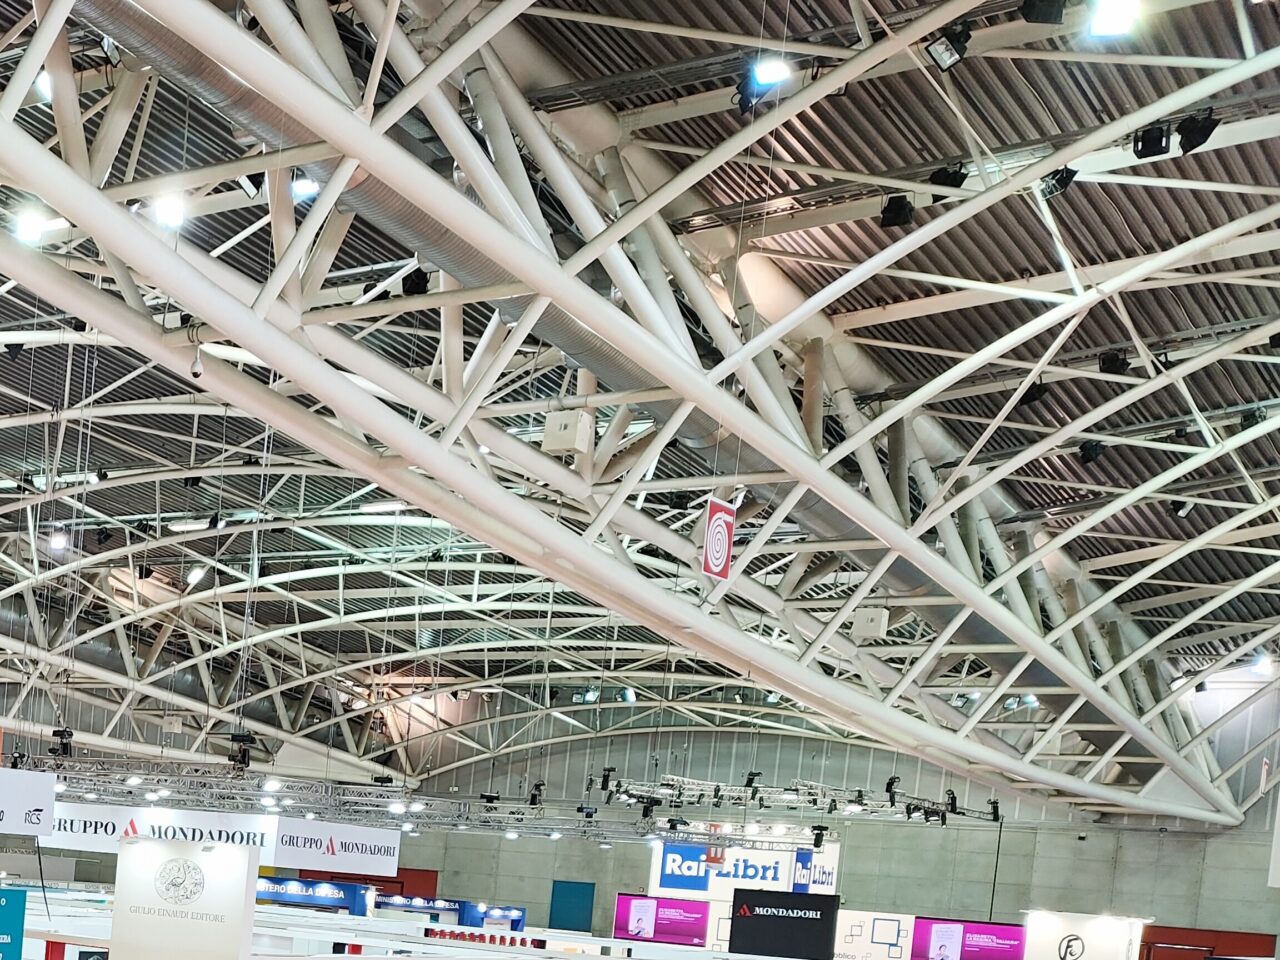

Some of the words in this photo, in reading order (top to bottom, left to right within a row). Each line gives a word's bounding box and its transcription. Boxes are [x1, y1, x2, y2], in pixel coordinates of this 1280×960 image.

[24, 810, 42, 825] RCS
[148, 823, 269, 848] MONDADORI
[280, 834, 323, 850] GRUPPO
[337, 840, 396, 857] MONDADORI
[665, 853, 707, 877] Rai
[715, 858, 780, 882] Libri
[796, 861, 811, 884] Rai
[812, 864, 834, 887] Libri
[129, 905, 156, 916] GIULIO
[157, 908, 189, 919] EINAUDI
[191, 911, 225, 923] EDITORE
[753, 906, 822, 919] MONDADORI
